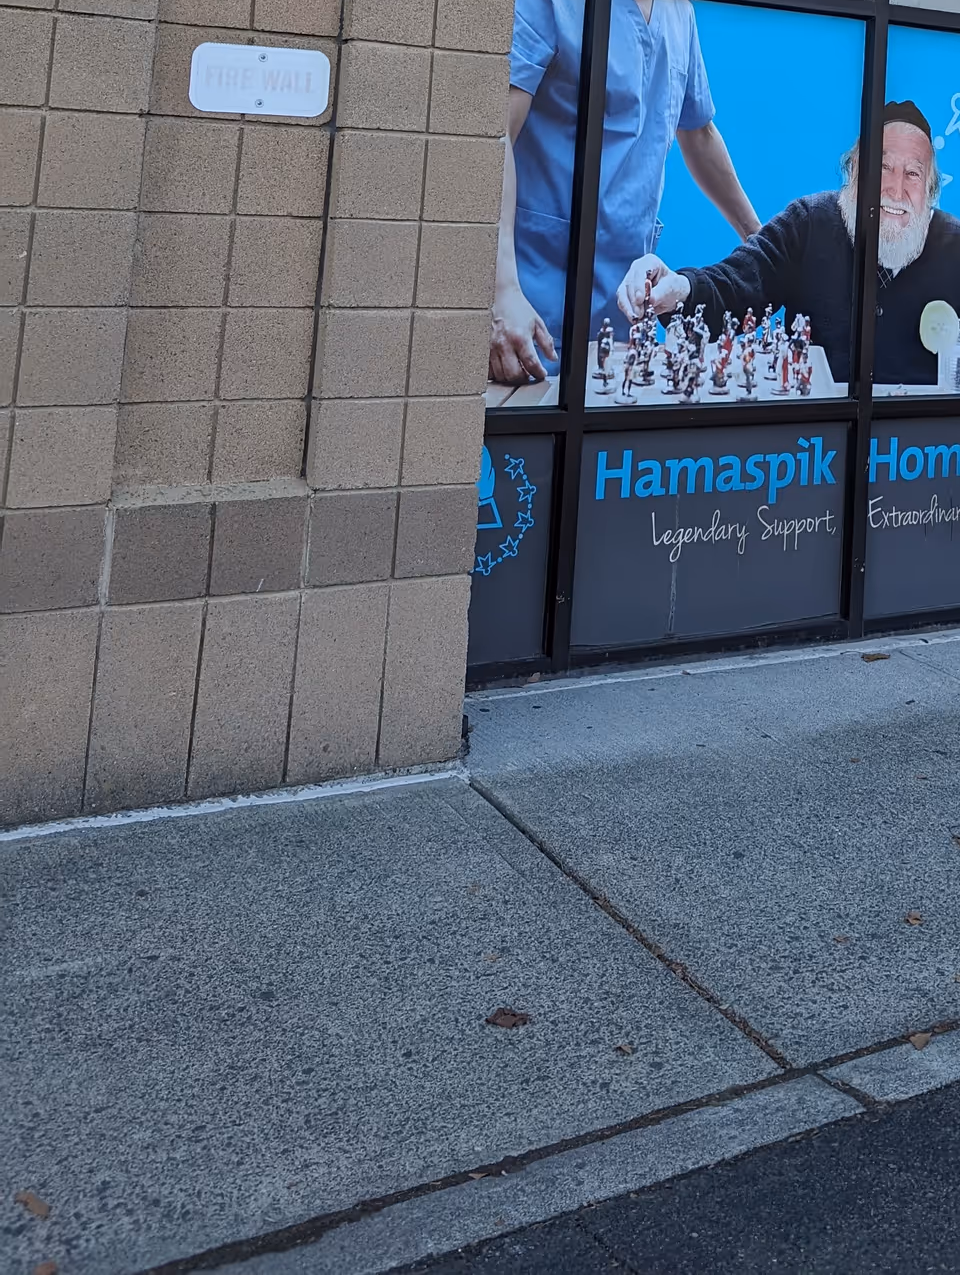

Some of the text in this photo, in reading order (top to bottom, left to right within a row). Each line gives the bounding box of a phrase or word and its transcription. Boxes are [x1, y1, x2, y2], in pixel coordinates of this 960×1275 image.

[204, 65, 320, 94] FIRE WALL
[651, 509, 750, 563] Legendary
[757, 505, 838, 552] Support,
